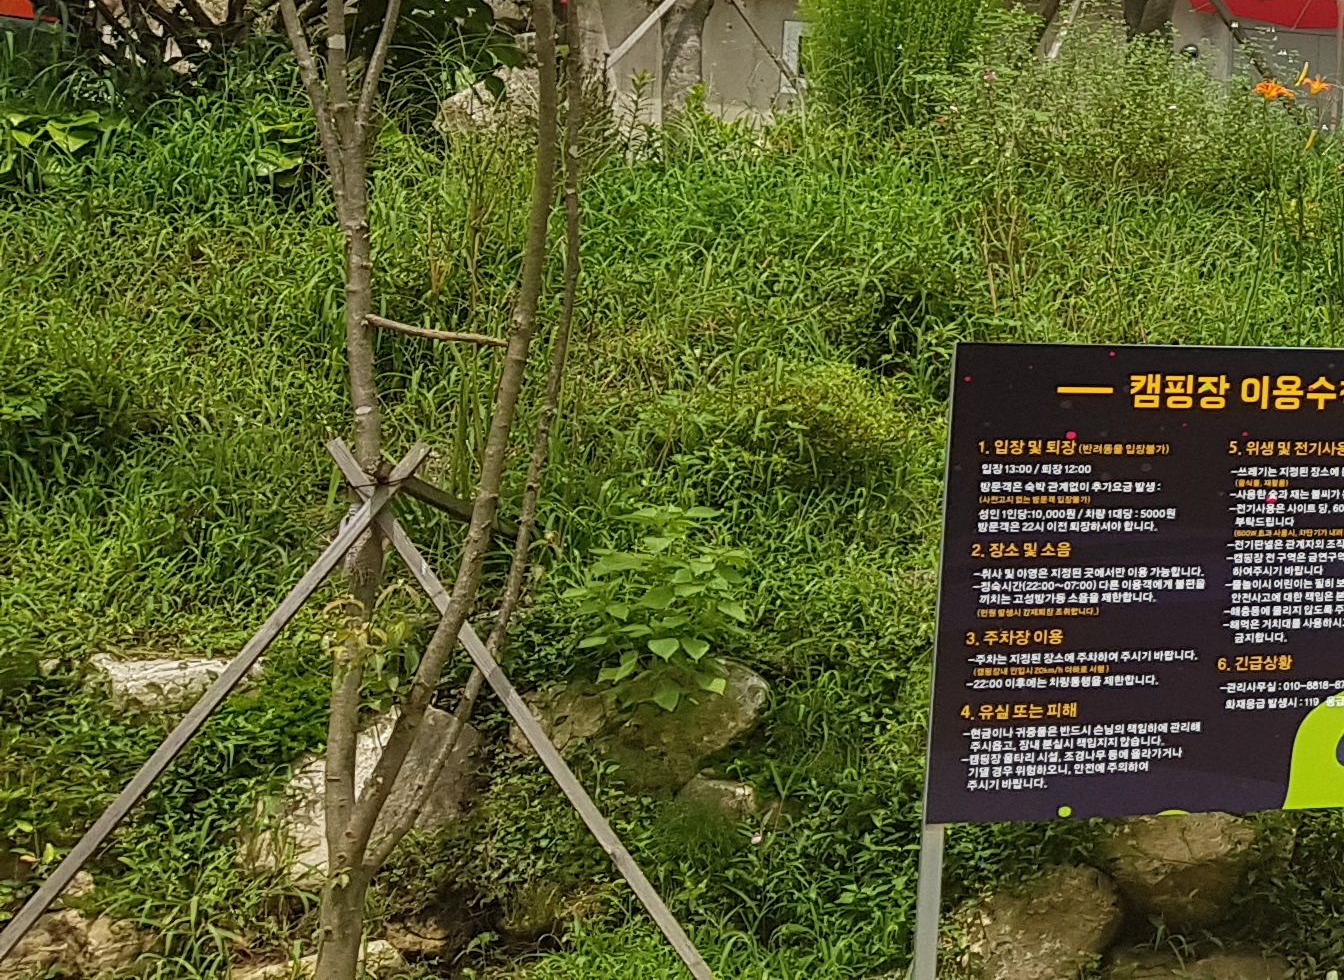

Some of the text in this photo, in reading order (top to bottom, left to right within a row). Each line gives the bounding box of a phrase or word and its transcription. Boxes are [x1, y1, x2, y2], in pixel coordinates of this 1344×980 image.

[1129, 374, 1230, 409] 캠핑장
[978, 441, 989, 454] 1.
[995, 440, 1025, 454] 입장
[1028, 440, 1042, 454] 및
[1046, 440, 1077, 454] 퇴장
[1229, 441, 1242, 455] 5.
[1246, 441, 1274, 456] 위생
[1278, 441, 1290, 456] 및
[982, 464, 1092, 475] 입장 13:00 퇴장 12:00
[980, 482, 1023, 493] 방문객은
[978, 509, 1000, 520] 성인
[1140, 508, 1176, 519] 5000원
[978, 522, 1021, 533] 방문객은
[1022, 522, 1044, 532] 22시
[1047, 521, 1067, 532] 이전
[971, 542, 1072, 557] 2. 장소 및 소음
[1127, 567, 1148, 578] 이용
[966, 629, 1063, 646] 3. 주차장 이용
[1121, 650, 1151, 662] 주시기
[1217, 655, 1293, 671] 6. 긴급상황
[960, 703, 1078, 720] 4. 유실 또는 피해
[967, 779, 1000, 791] 주시기
